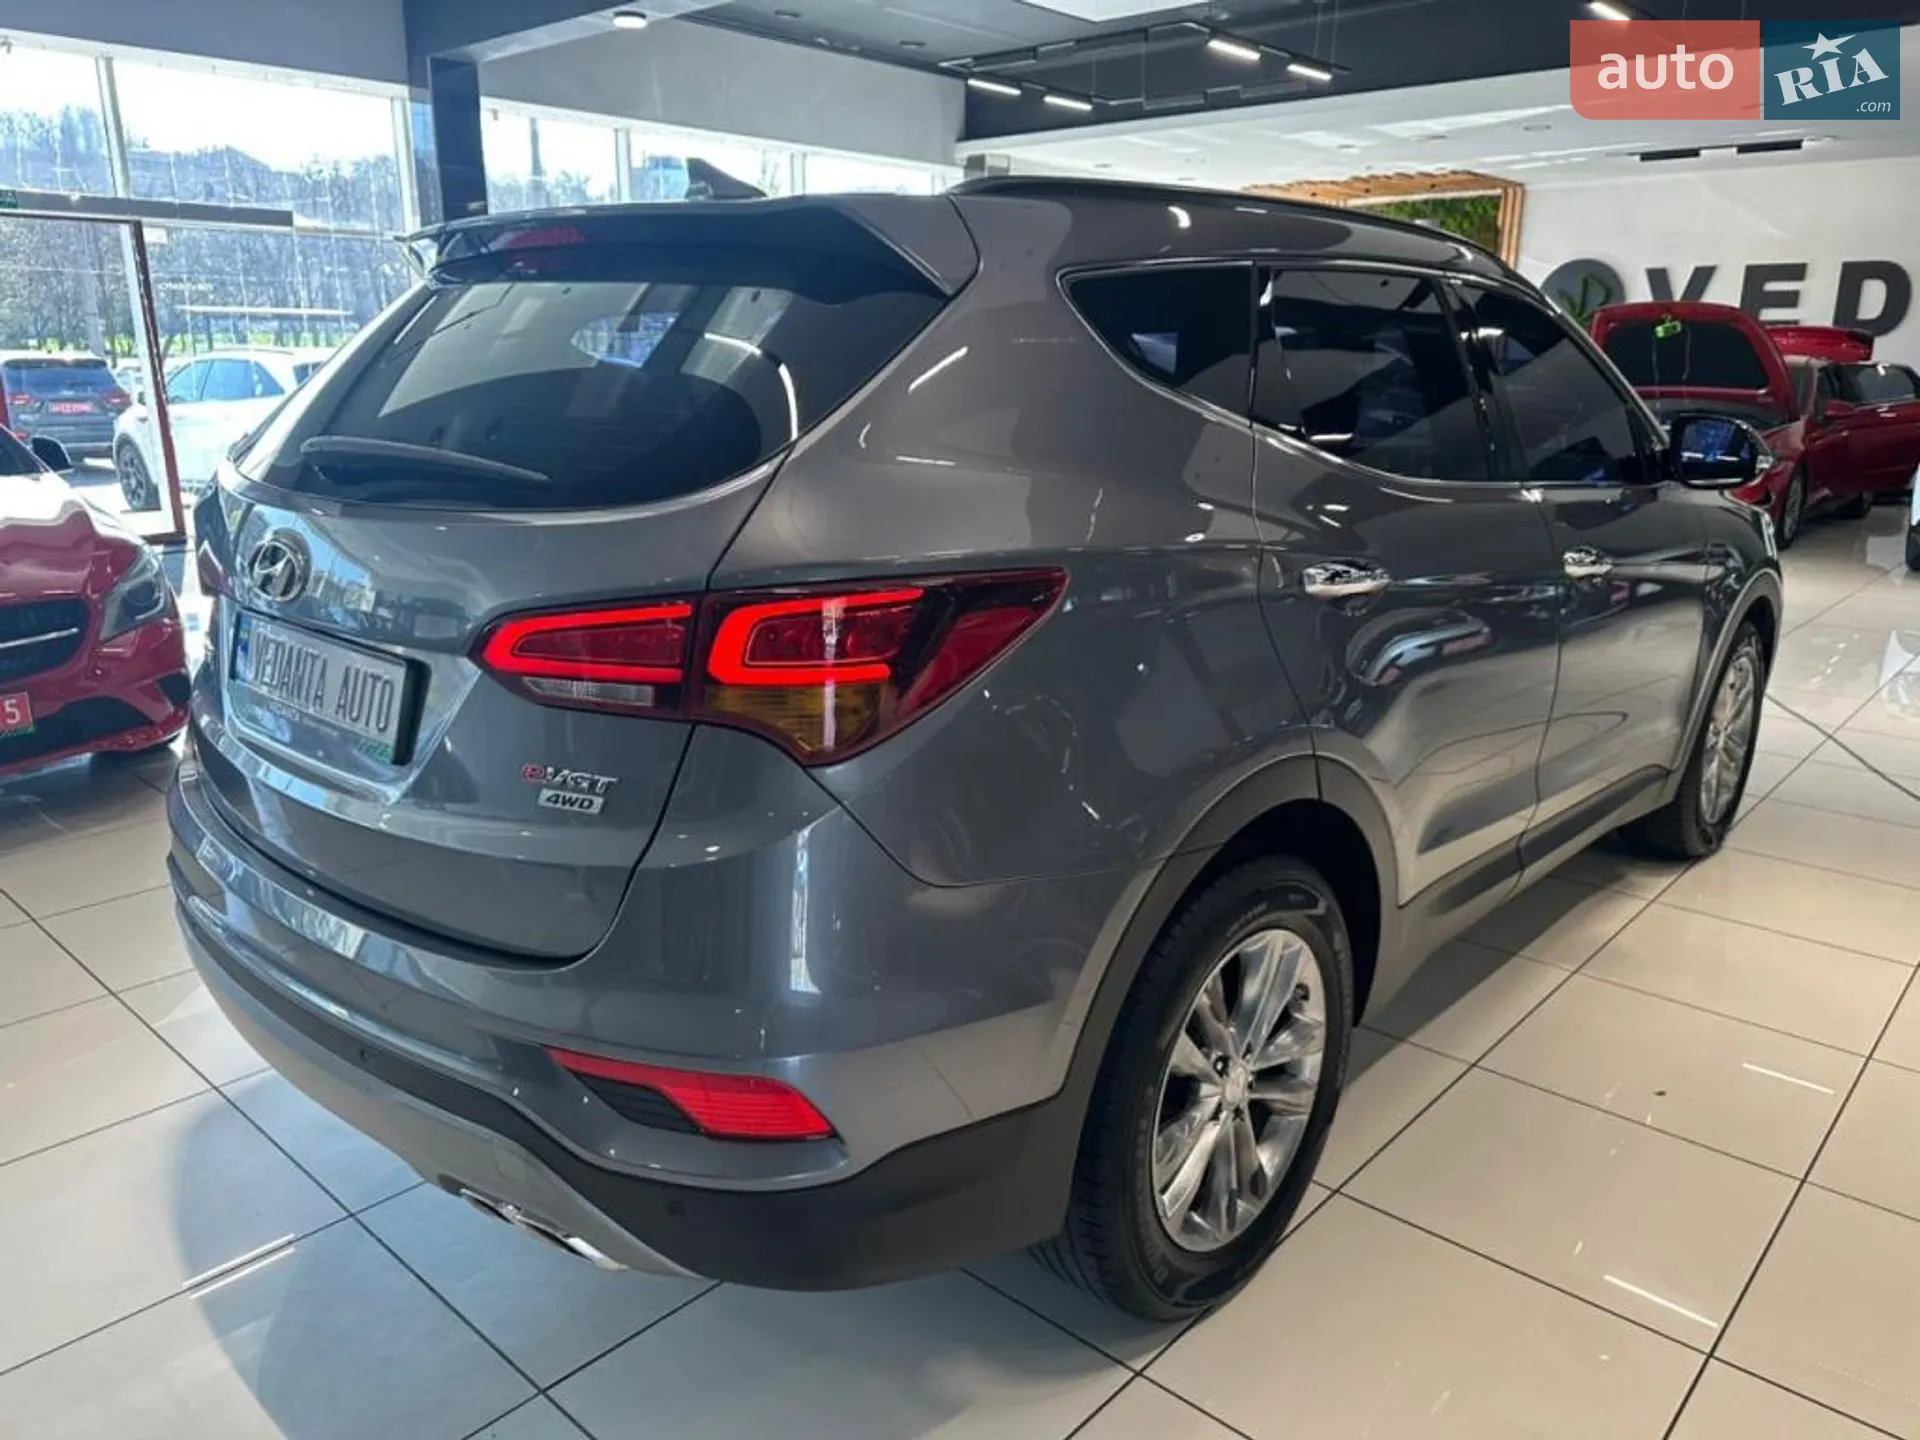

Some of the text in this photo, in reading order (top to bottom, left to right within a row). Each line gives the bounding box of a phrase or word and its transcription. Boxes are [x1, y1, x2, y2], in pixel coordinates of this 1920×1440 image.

[253, 631, 328, 709] VEDANTA
[335, 664, 395, 734] AUTO
[546, 793, 594, 810] 4WD
